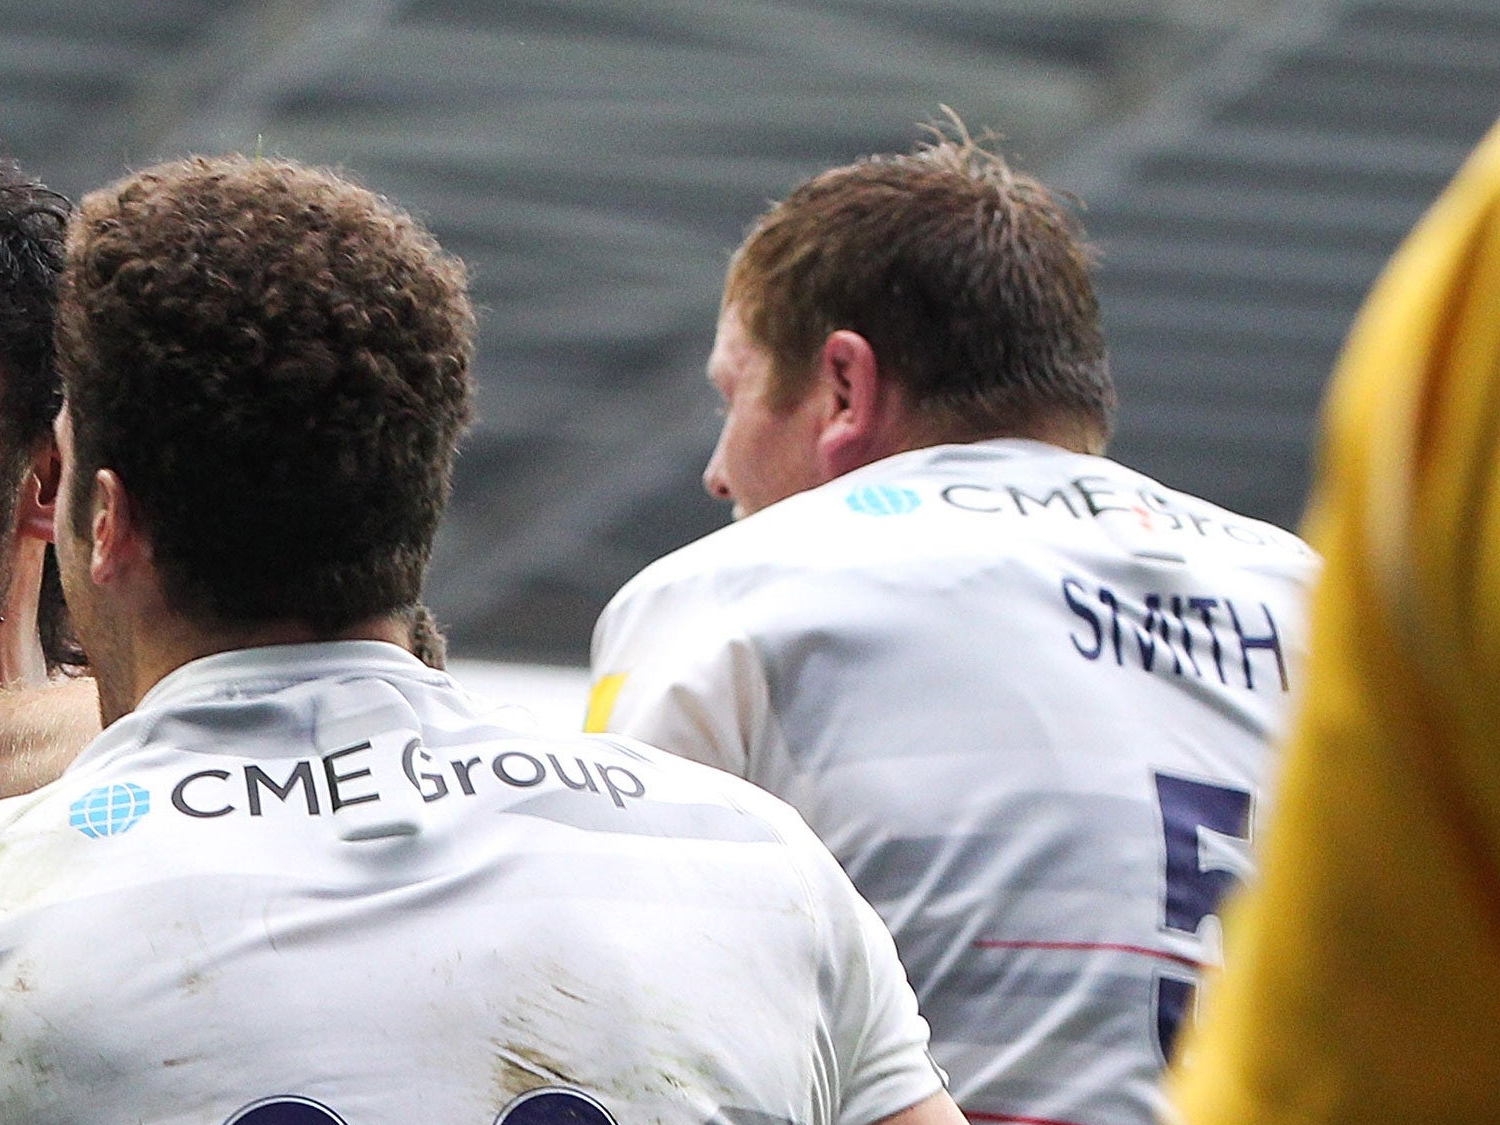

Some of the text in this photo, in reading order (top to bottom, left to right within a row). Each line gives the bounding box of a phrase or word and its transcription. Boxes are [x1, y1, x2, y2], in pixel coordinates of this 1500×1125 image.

[1063, 577, 1289, 692] SMITH
[170, 737, 646, 818] CME Group
